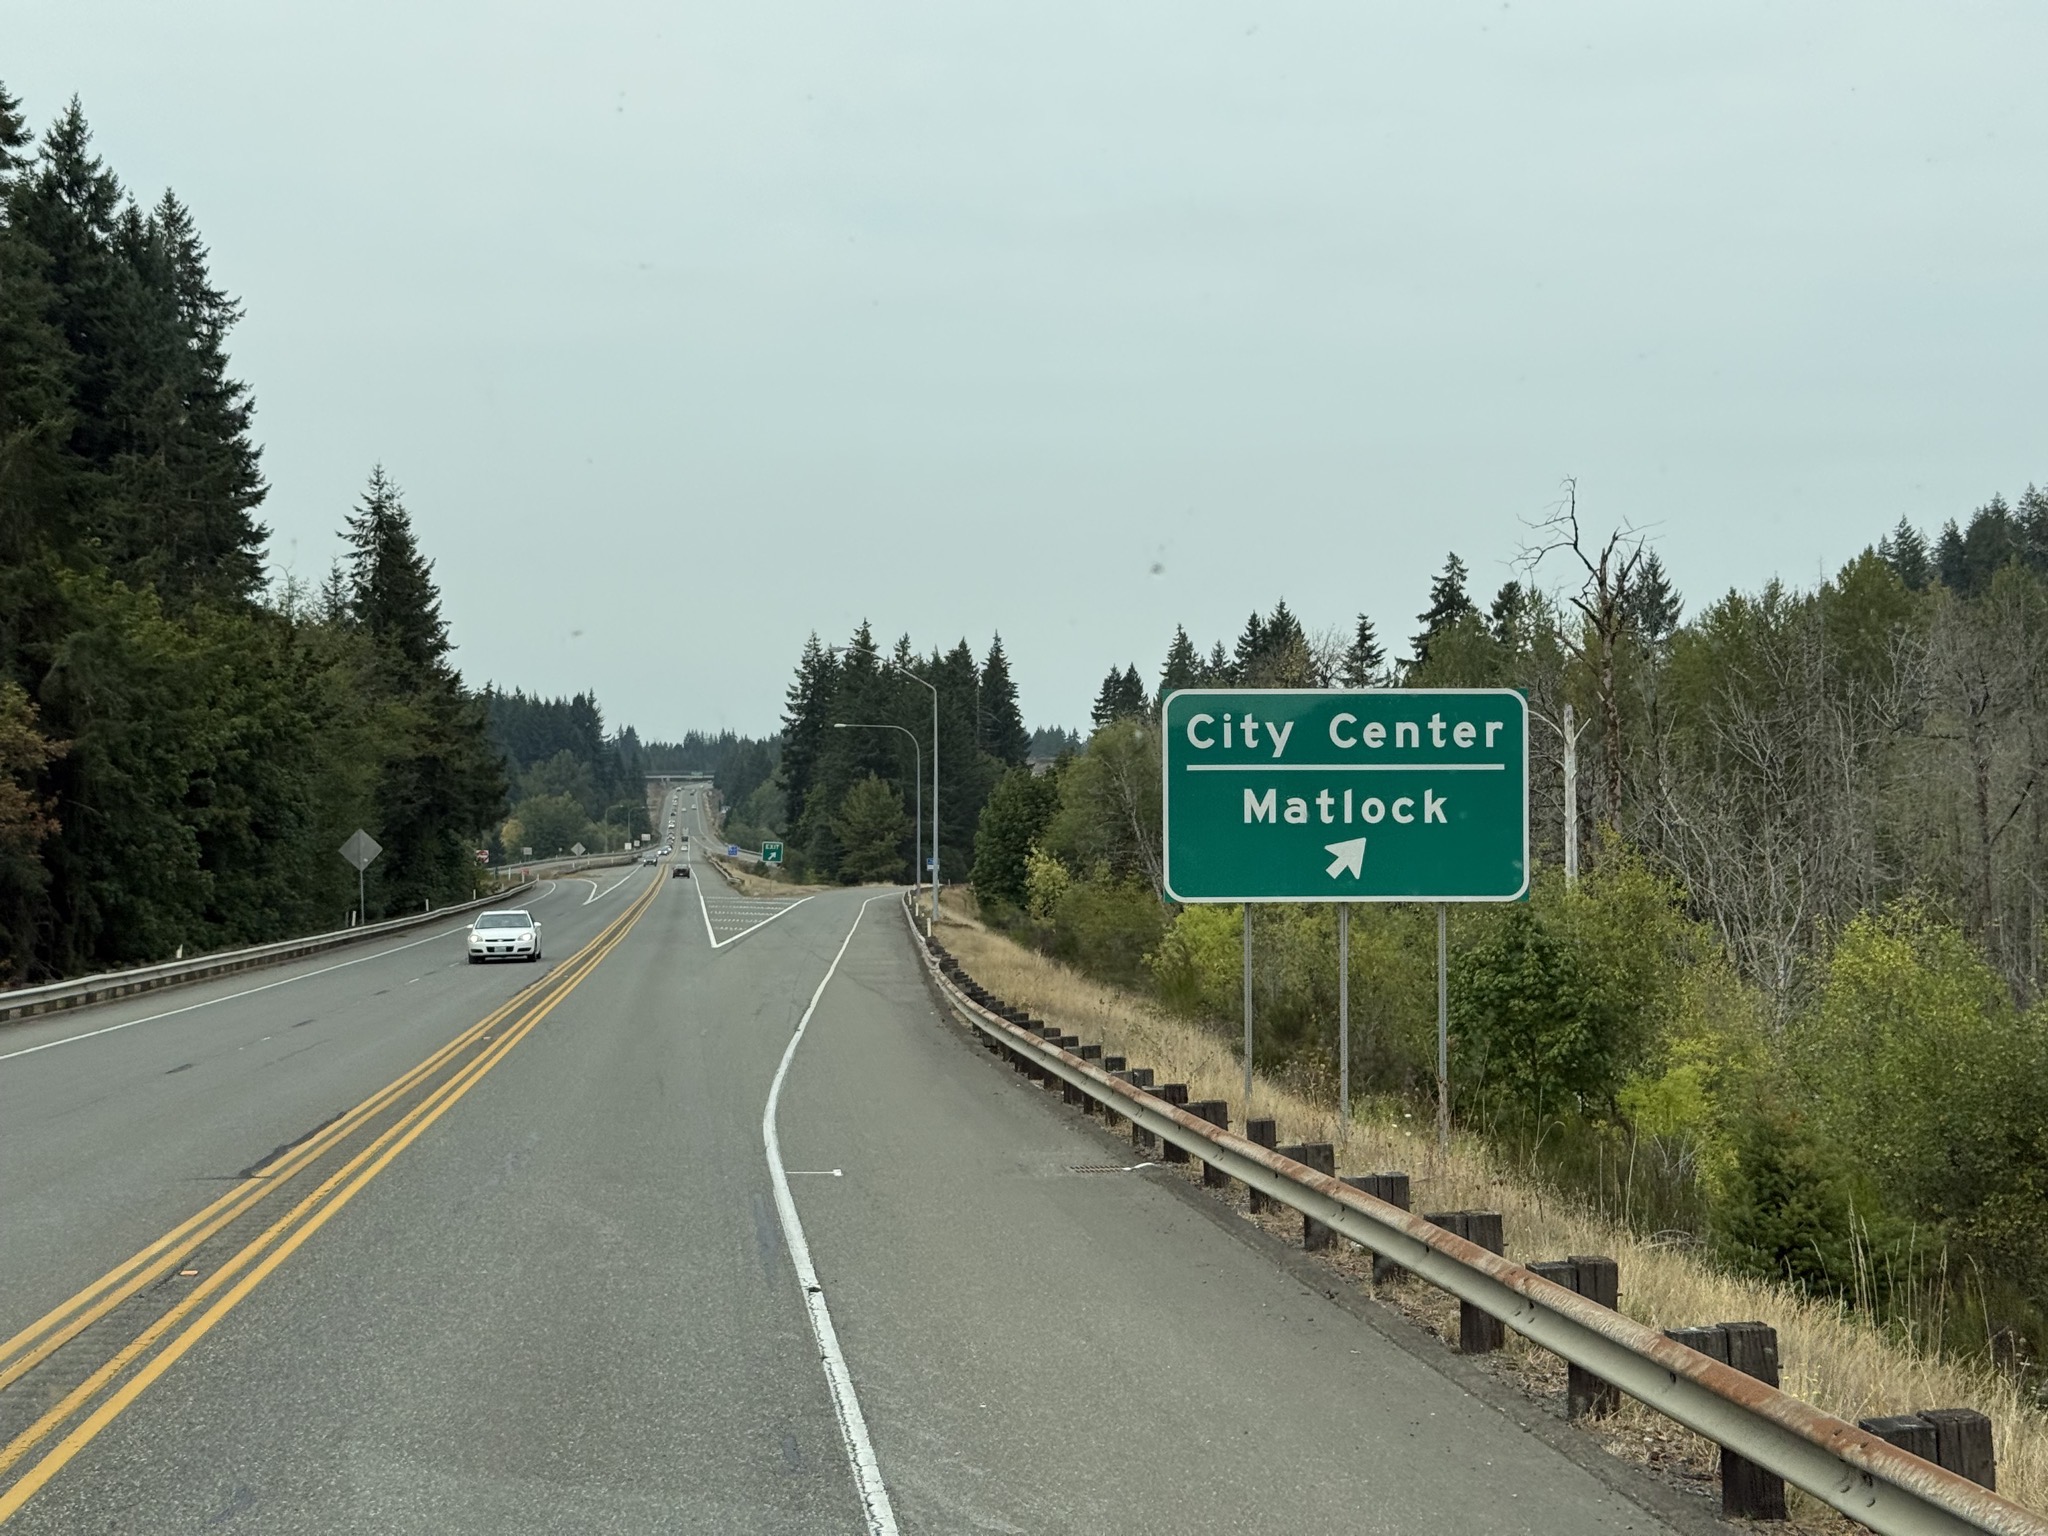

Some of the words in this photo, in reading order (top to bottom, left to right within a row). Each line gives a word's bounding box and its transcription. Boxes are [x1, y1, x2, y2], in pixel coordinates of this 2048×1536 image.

[1187, 713, 1294, 758] City
[1329, 712, 1504, 748] Center
[1243, 788, 1448, 824] Matlock
